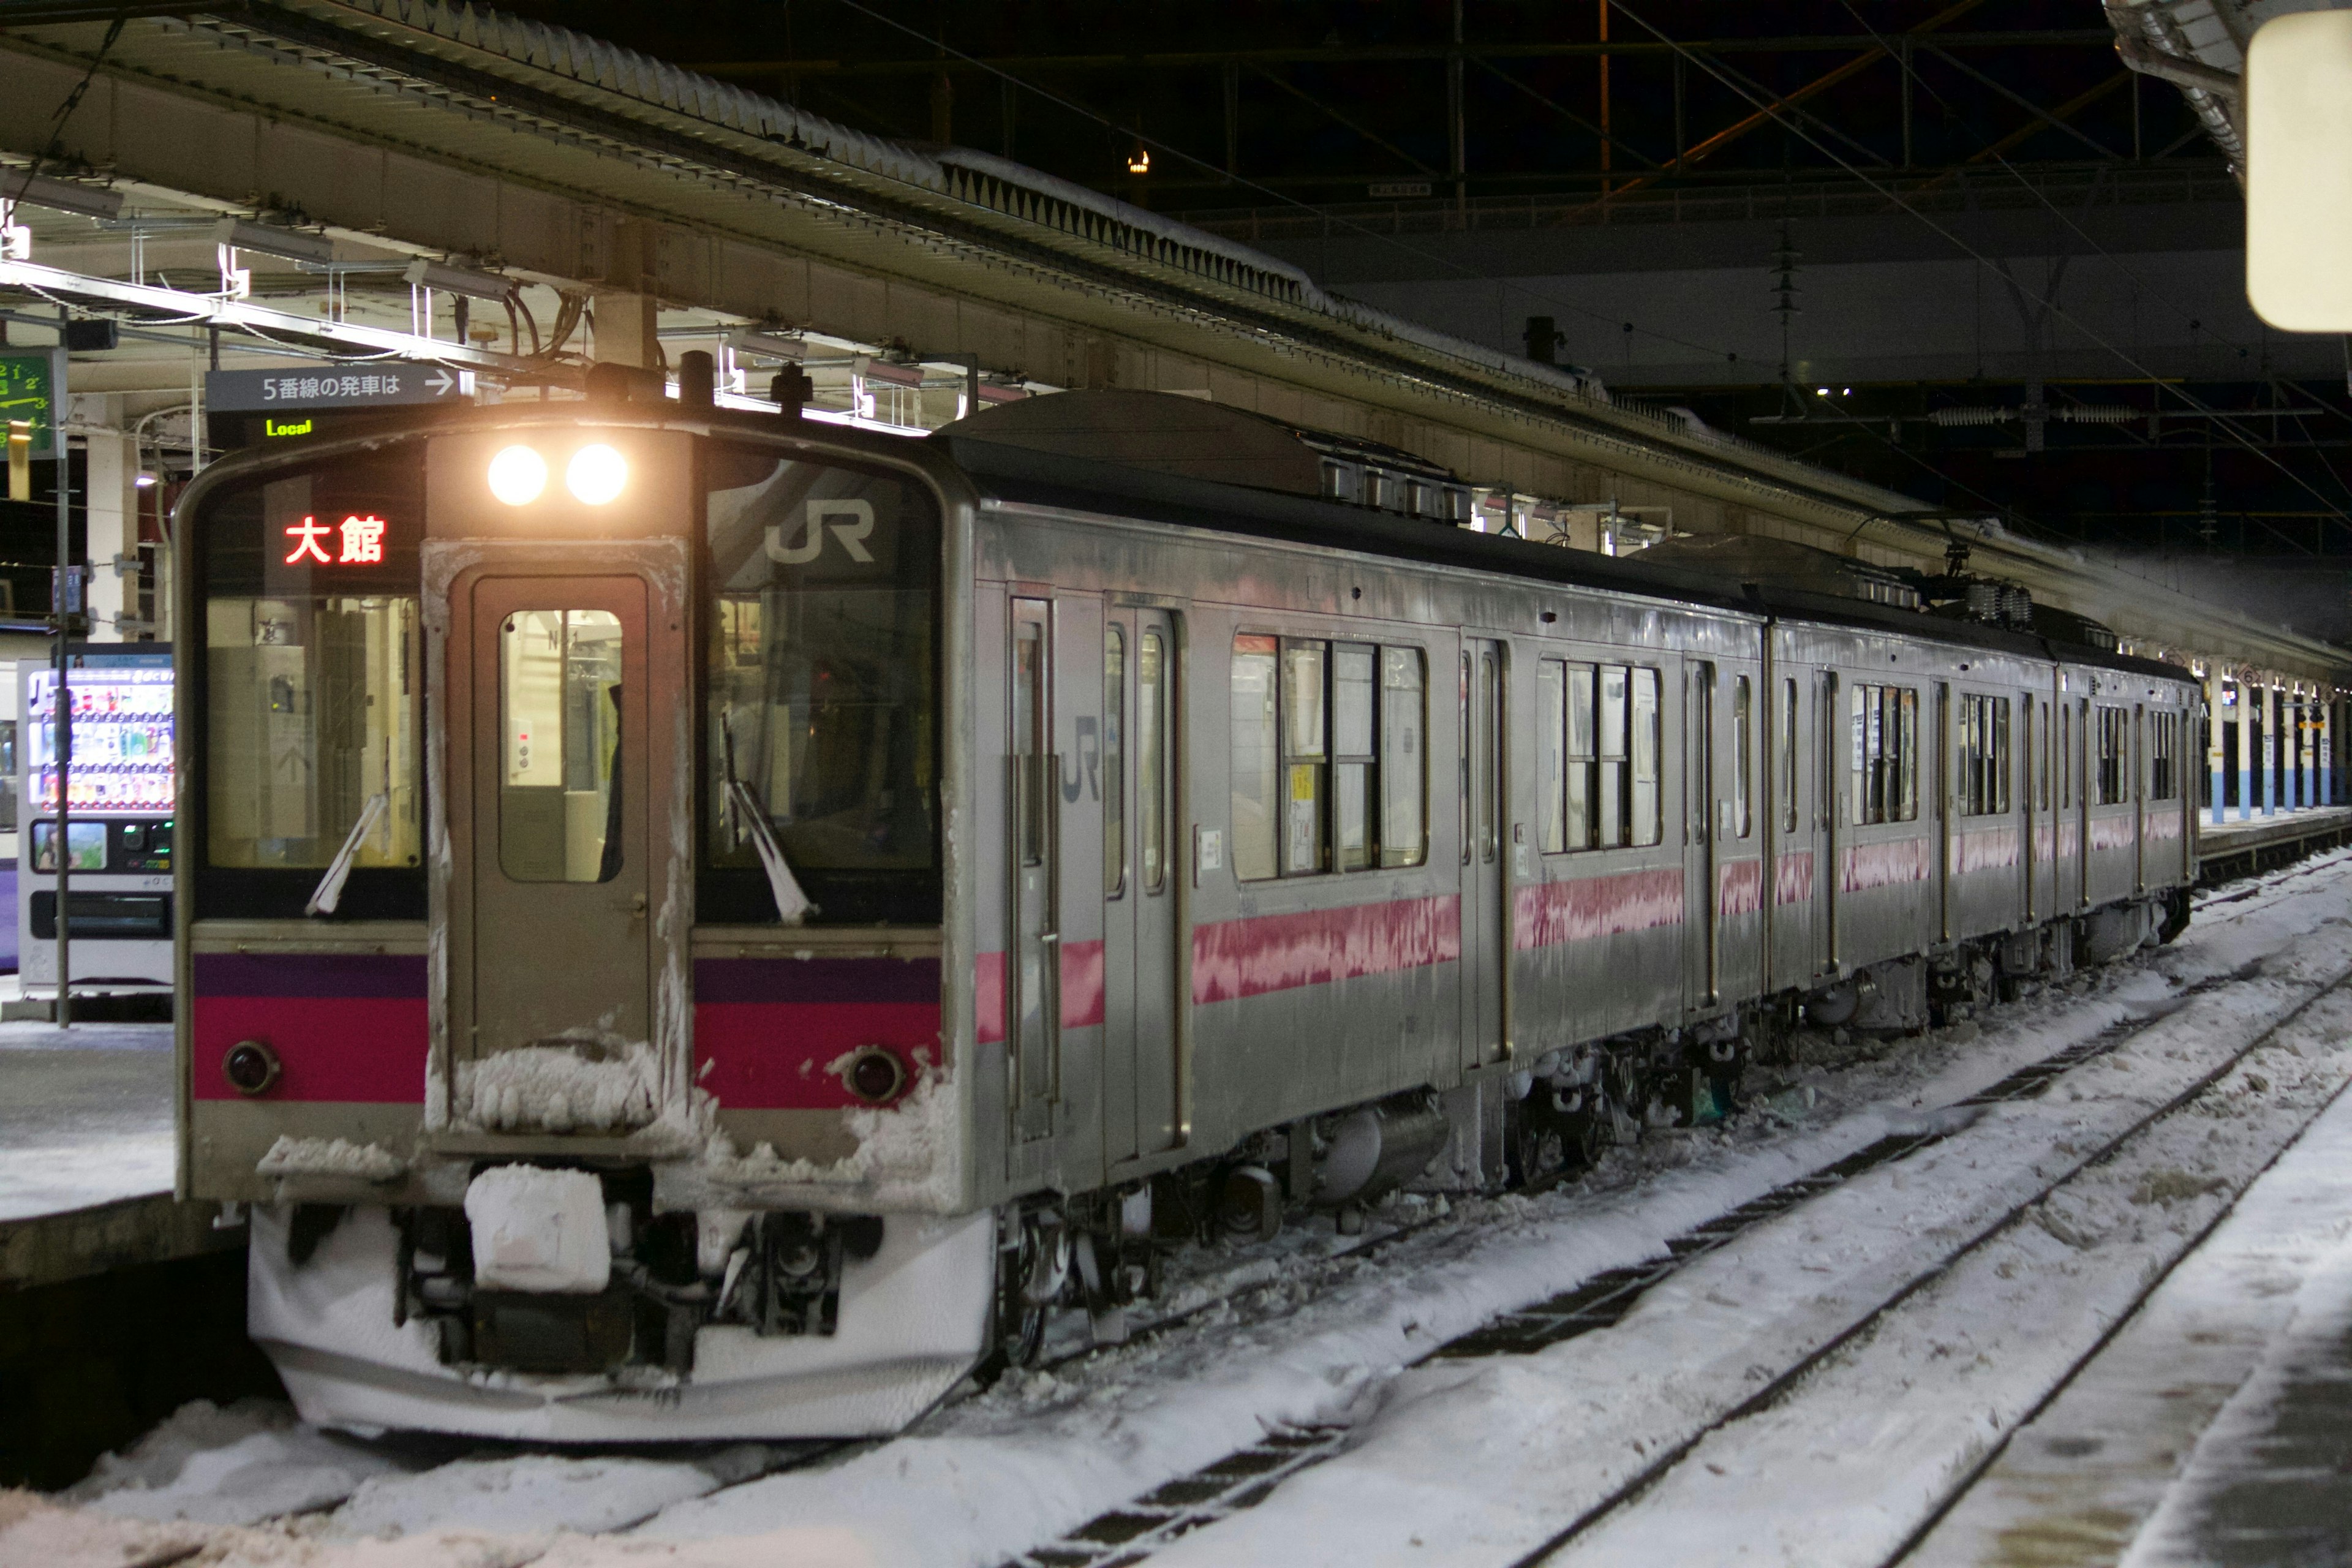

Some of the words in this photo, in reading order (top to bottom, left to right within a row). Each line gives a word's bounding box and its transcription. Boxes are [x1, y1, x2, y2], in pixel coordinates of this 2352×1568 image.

[25, 377, 37, 390] 2
[263, 375, 400, 401] 5番線の発車は
[35, 398, 47, 409] 3
[266, 419, 312, 436] Local
[284, 516, 385, 564] 大館
[765, 499, 875, 564] JR
[2244, 671, 2253, 683] 6
[1061, 715, 1099, 804] JR
